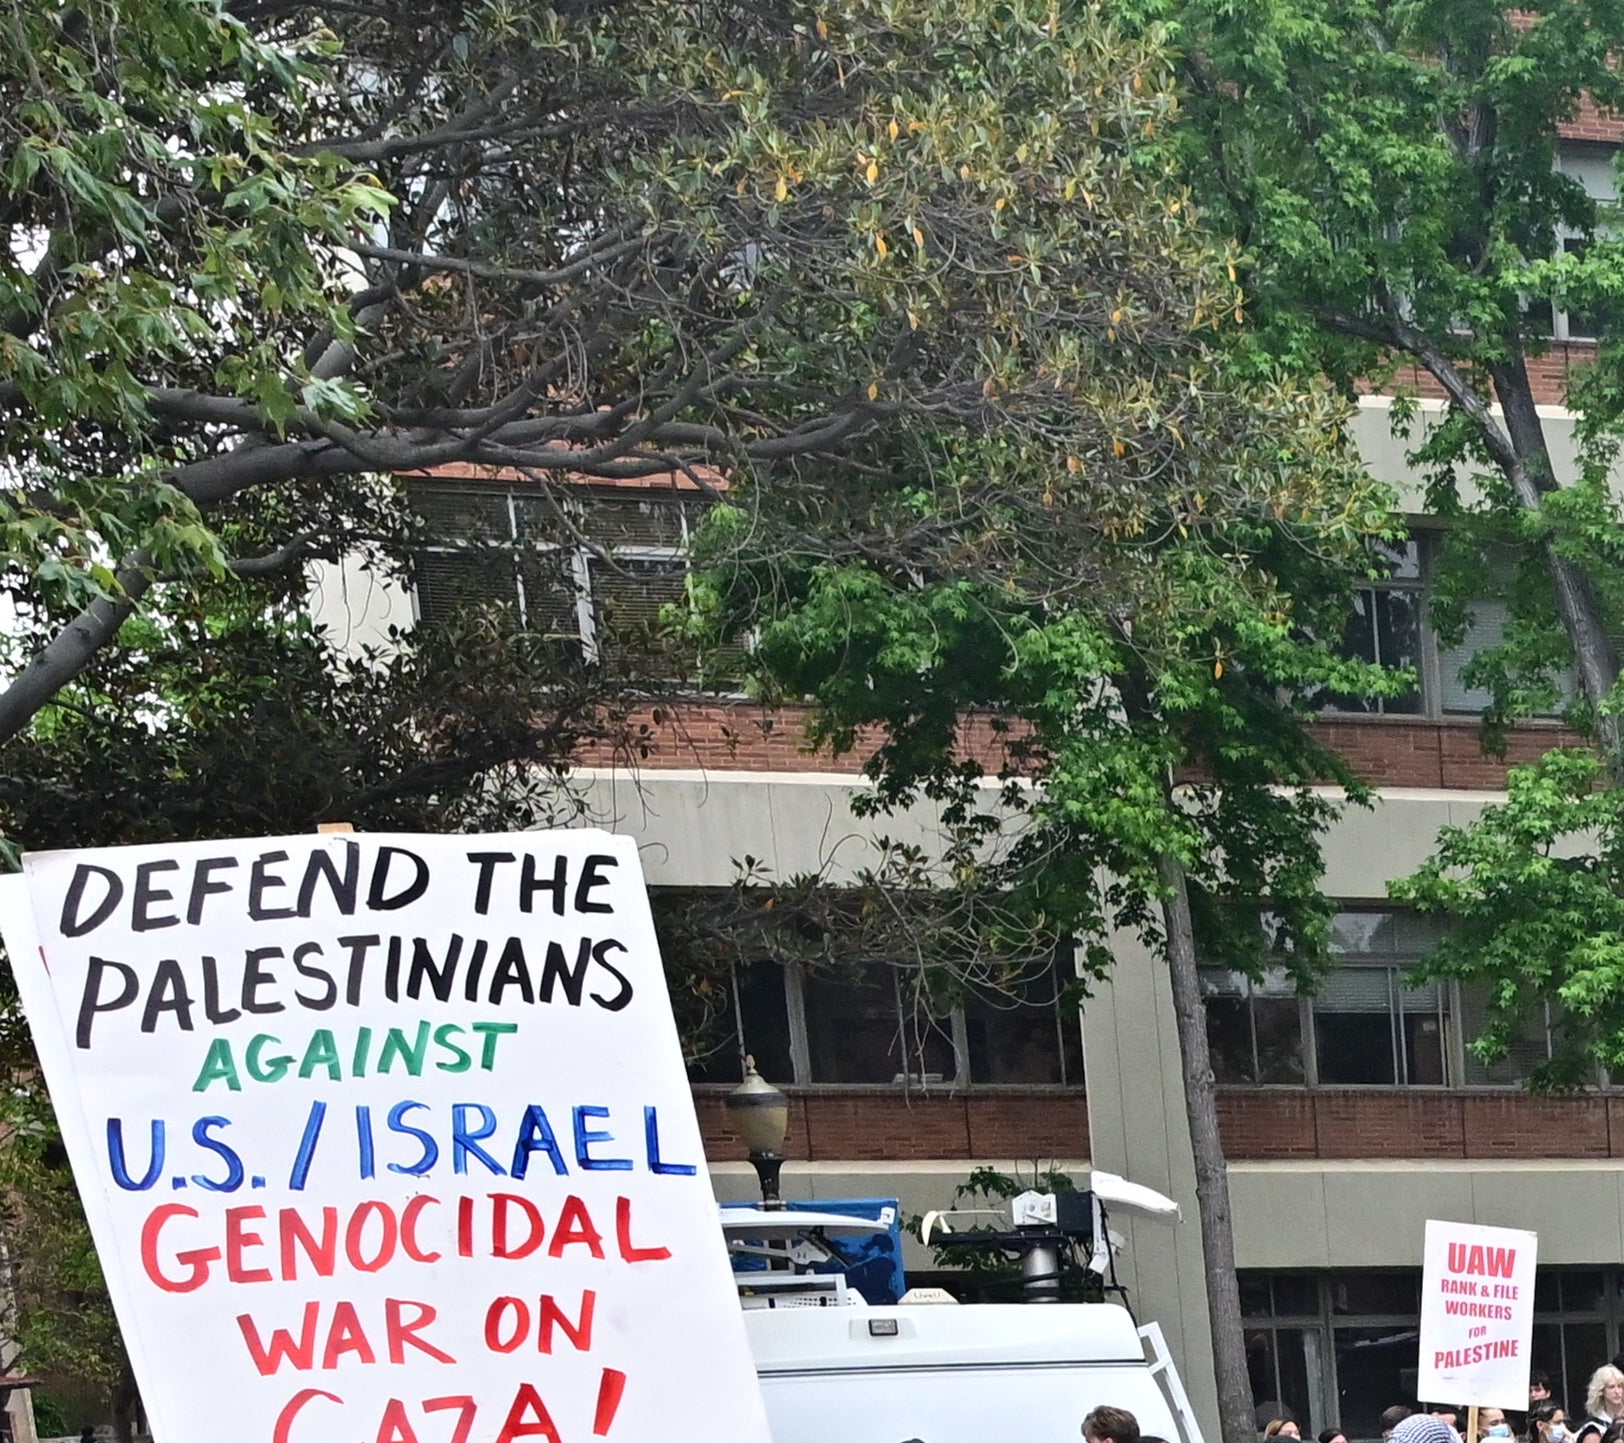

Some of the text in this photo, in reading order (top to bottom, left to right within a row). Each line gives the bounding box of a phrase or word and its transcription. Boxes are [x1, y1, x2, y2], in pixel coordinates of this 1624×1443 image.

[59, 839, 620, 938] DEFEND THE
[74, 932, 634, 1050] PALESTINIANS
[191, 1020, 519, 1094] AGAINST
[140, 1193, 673, 1294] GENOCIDAL
[1448, 1242, 1516, 1278] UAW
[1441, 1279, 1519, 1300] RANK & FILE
[1445, 1300, 1512, 1321] WORKERS
[236, 1290, 596, 1376] WAR ON
[1434, 1339, 1519, 1369] PALESTINE
[1468, 1325, 1487, 1339] FOR
